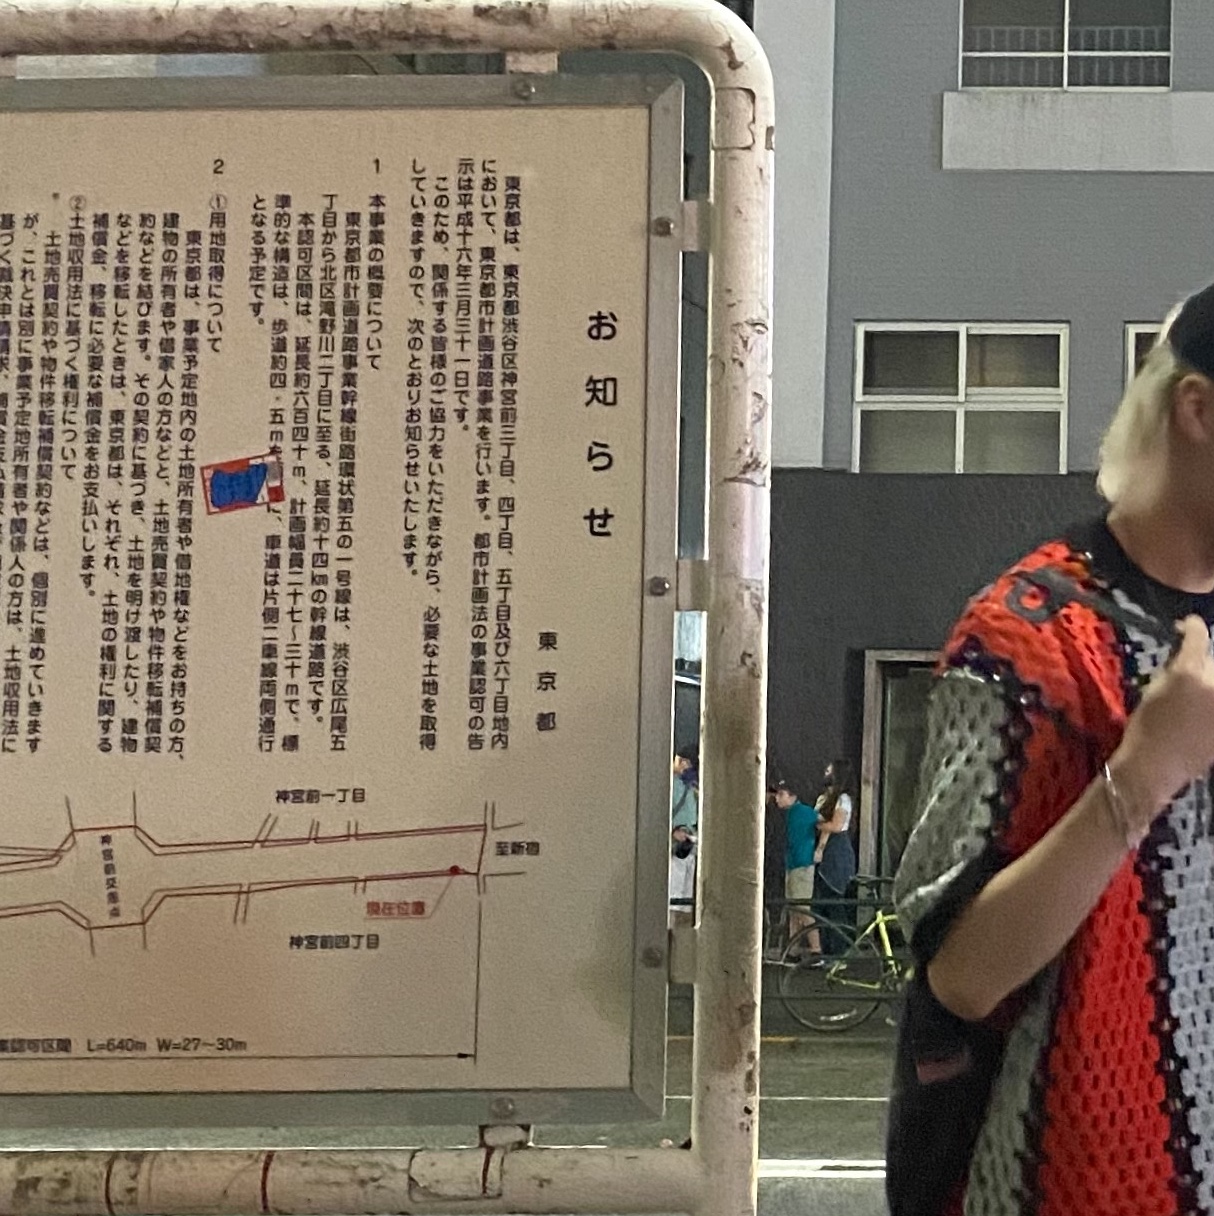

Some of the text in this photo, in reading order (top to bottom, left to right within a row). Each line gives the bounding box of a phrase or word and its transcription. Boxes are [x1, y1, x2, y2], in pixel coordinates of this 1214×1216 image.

[249, 195, 267, 326] となる予定です。
[583, 311, 618, 537] お知らせ
[535, 631, 558, 732] 東京都
